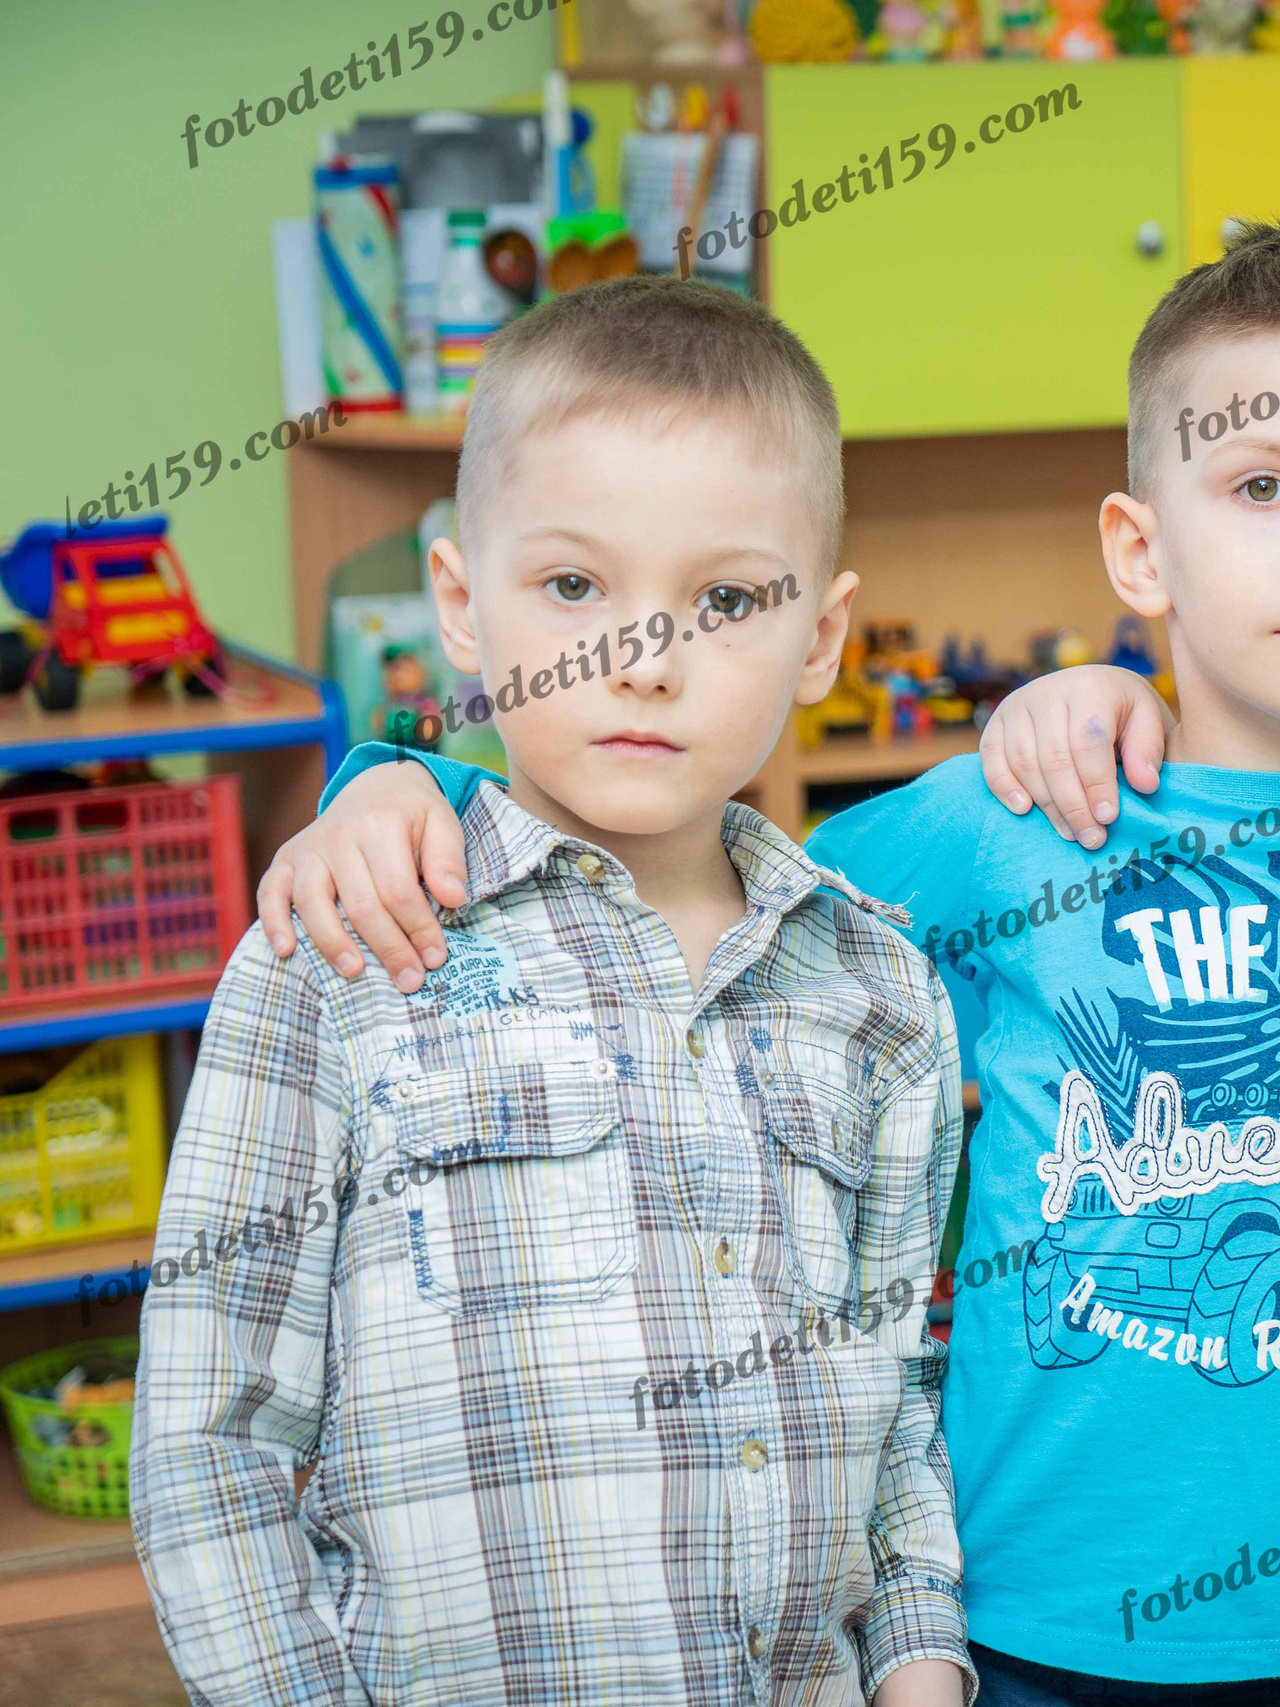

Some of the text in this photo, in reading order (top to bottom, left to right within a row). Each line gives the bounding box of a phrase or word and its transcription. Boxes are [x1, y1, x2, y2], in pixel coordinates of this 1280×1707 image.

[460, 956, 505, 974] AIRPLANE
[1114, 903, 1270, 1014] THE
[1058, 1272, 1229, 1370] Amazon
